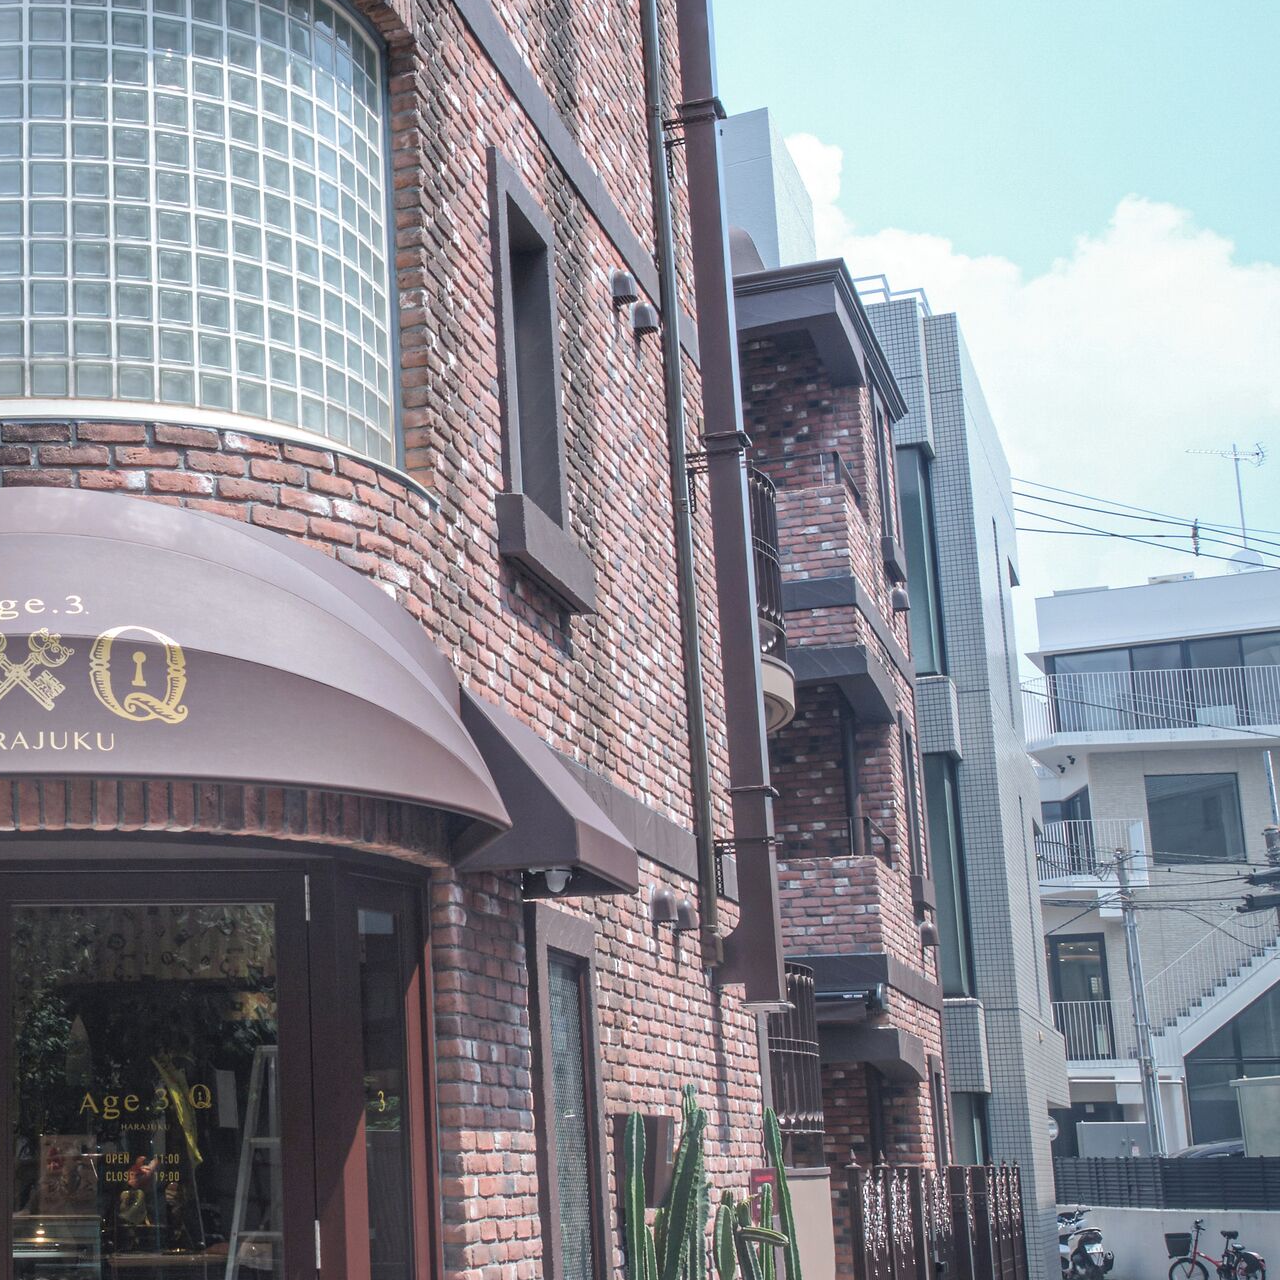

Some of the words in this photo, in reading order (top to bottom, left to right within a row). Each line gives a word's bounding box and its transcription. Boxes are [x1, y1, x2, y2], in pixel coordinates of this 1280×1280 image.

[89, 625, 189, 724] Q
[189, 1083, 212, 1110] Q
[105, 1153, 130, 1165] OPEN
